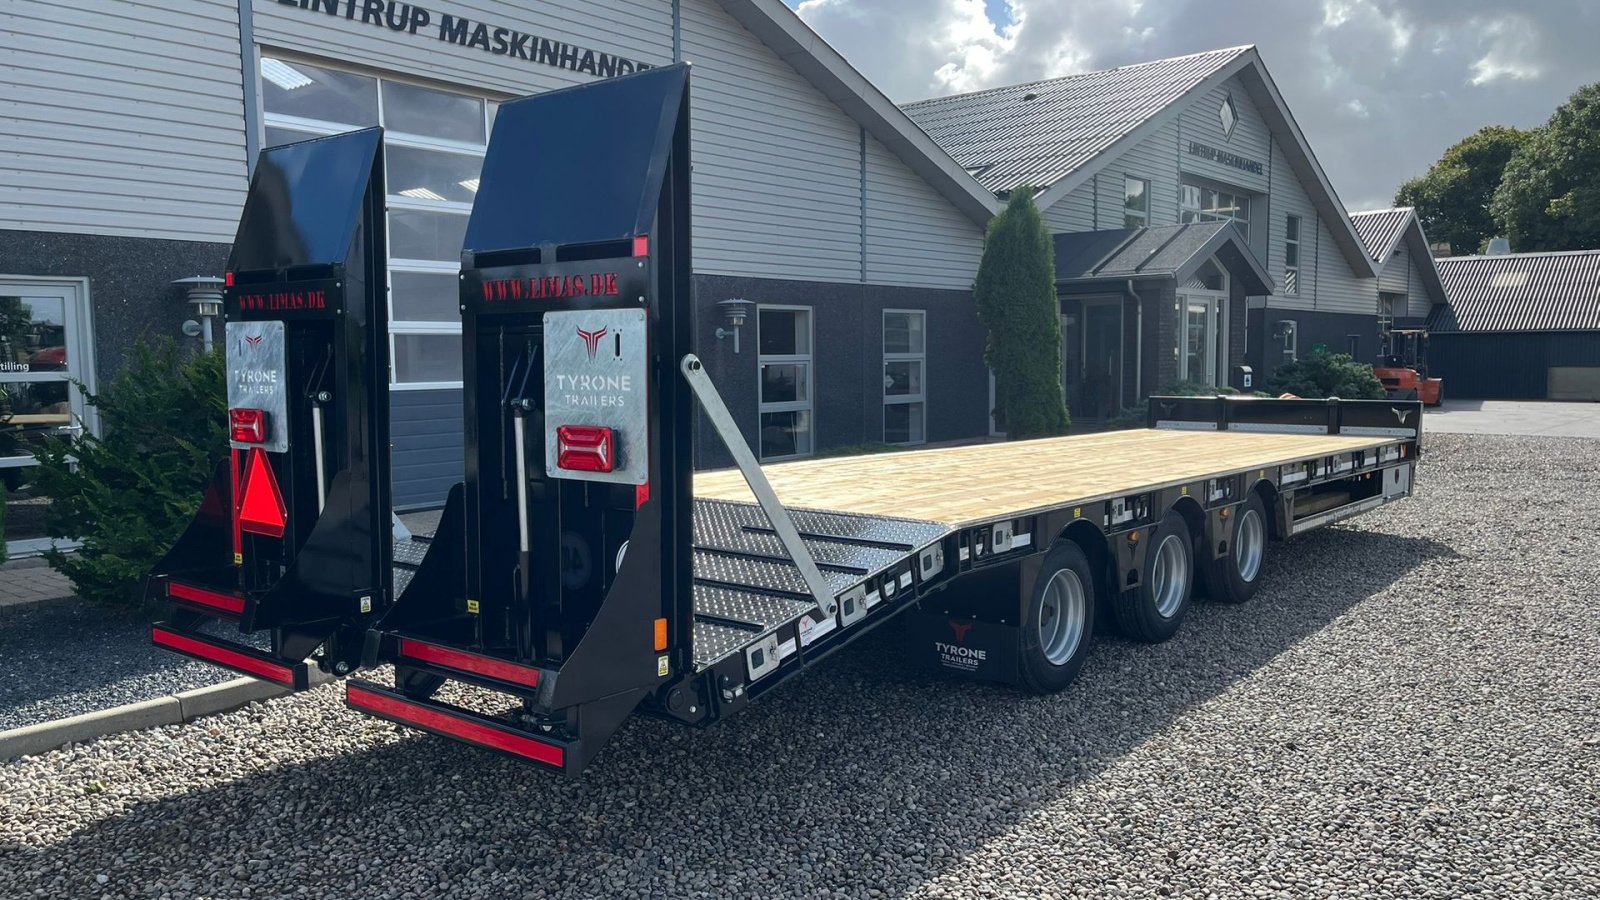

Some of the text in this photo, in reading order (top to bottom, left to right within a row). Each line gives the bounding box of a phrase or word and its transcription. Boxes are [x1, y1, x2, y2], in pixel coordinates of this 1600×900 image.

[439, 14, 656, 77] MASKINHAND
[482, 272, 620, 301] WWW.LIMAS.DK
[239, 290, 326, 311] WWW.LIMAS.DK
[234, 370, 277, 383] TYRONE
[556, 374, 632, 391] TYRONE
[239, 385, 274, 395] TRAILERS
[935, 642, 987, 660] TYRONE
[941, 653, 979, 666] TRAILERS
